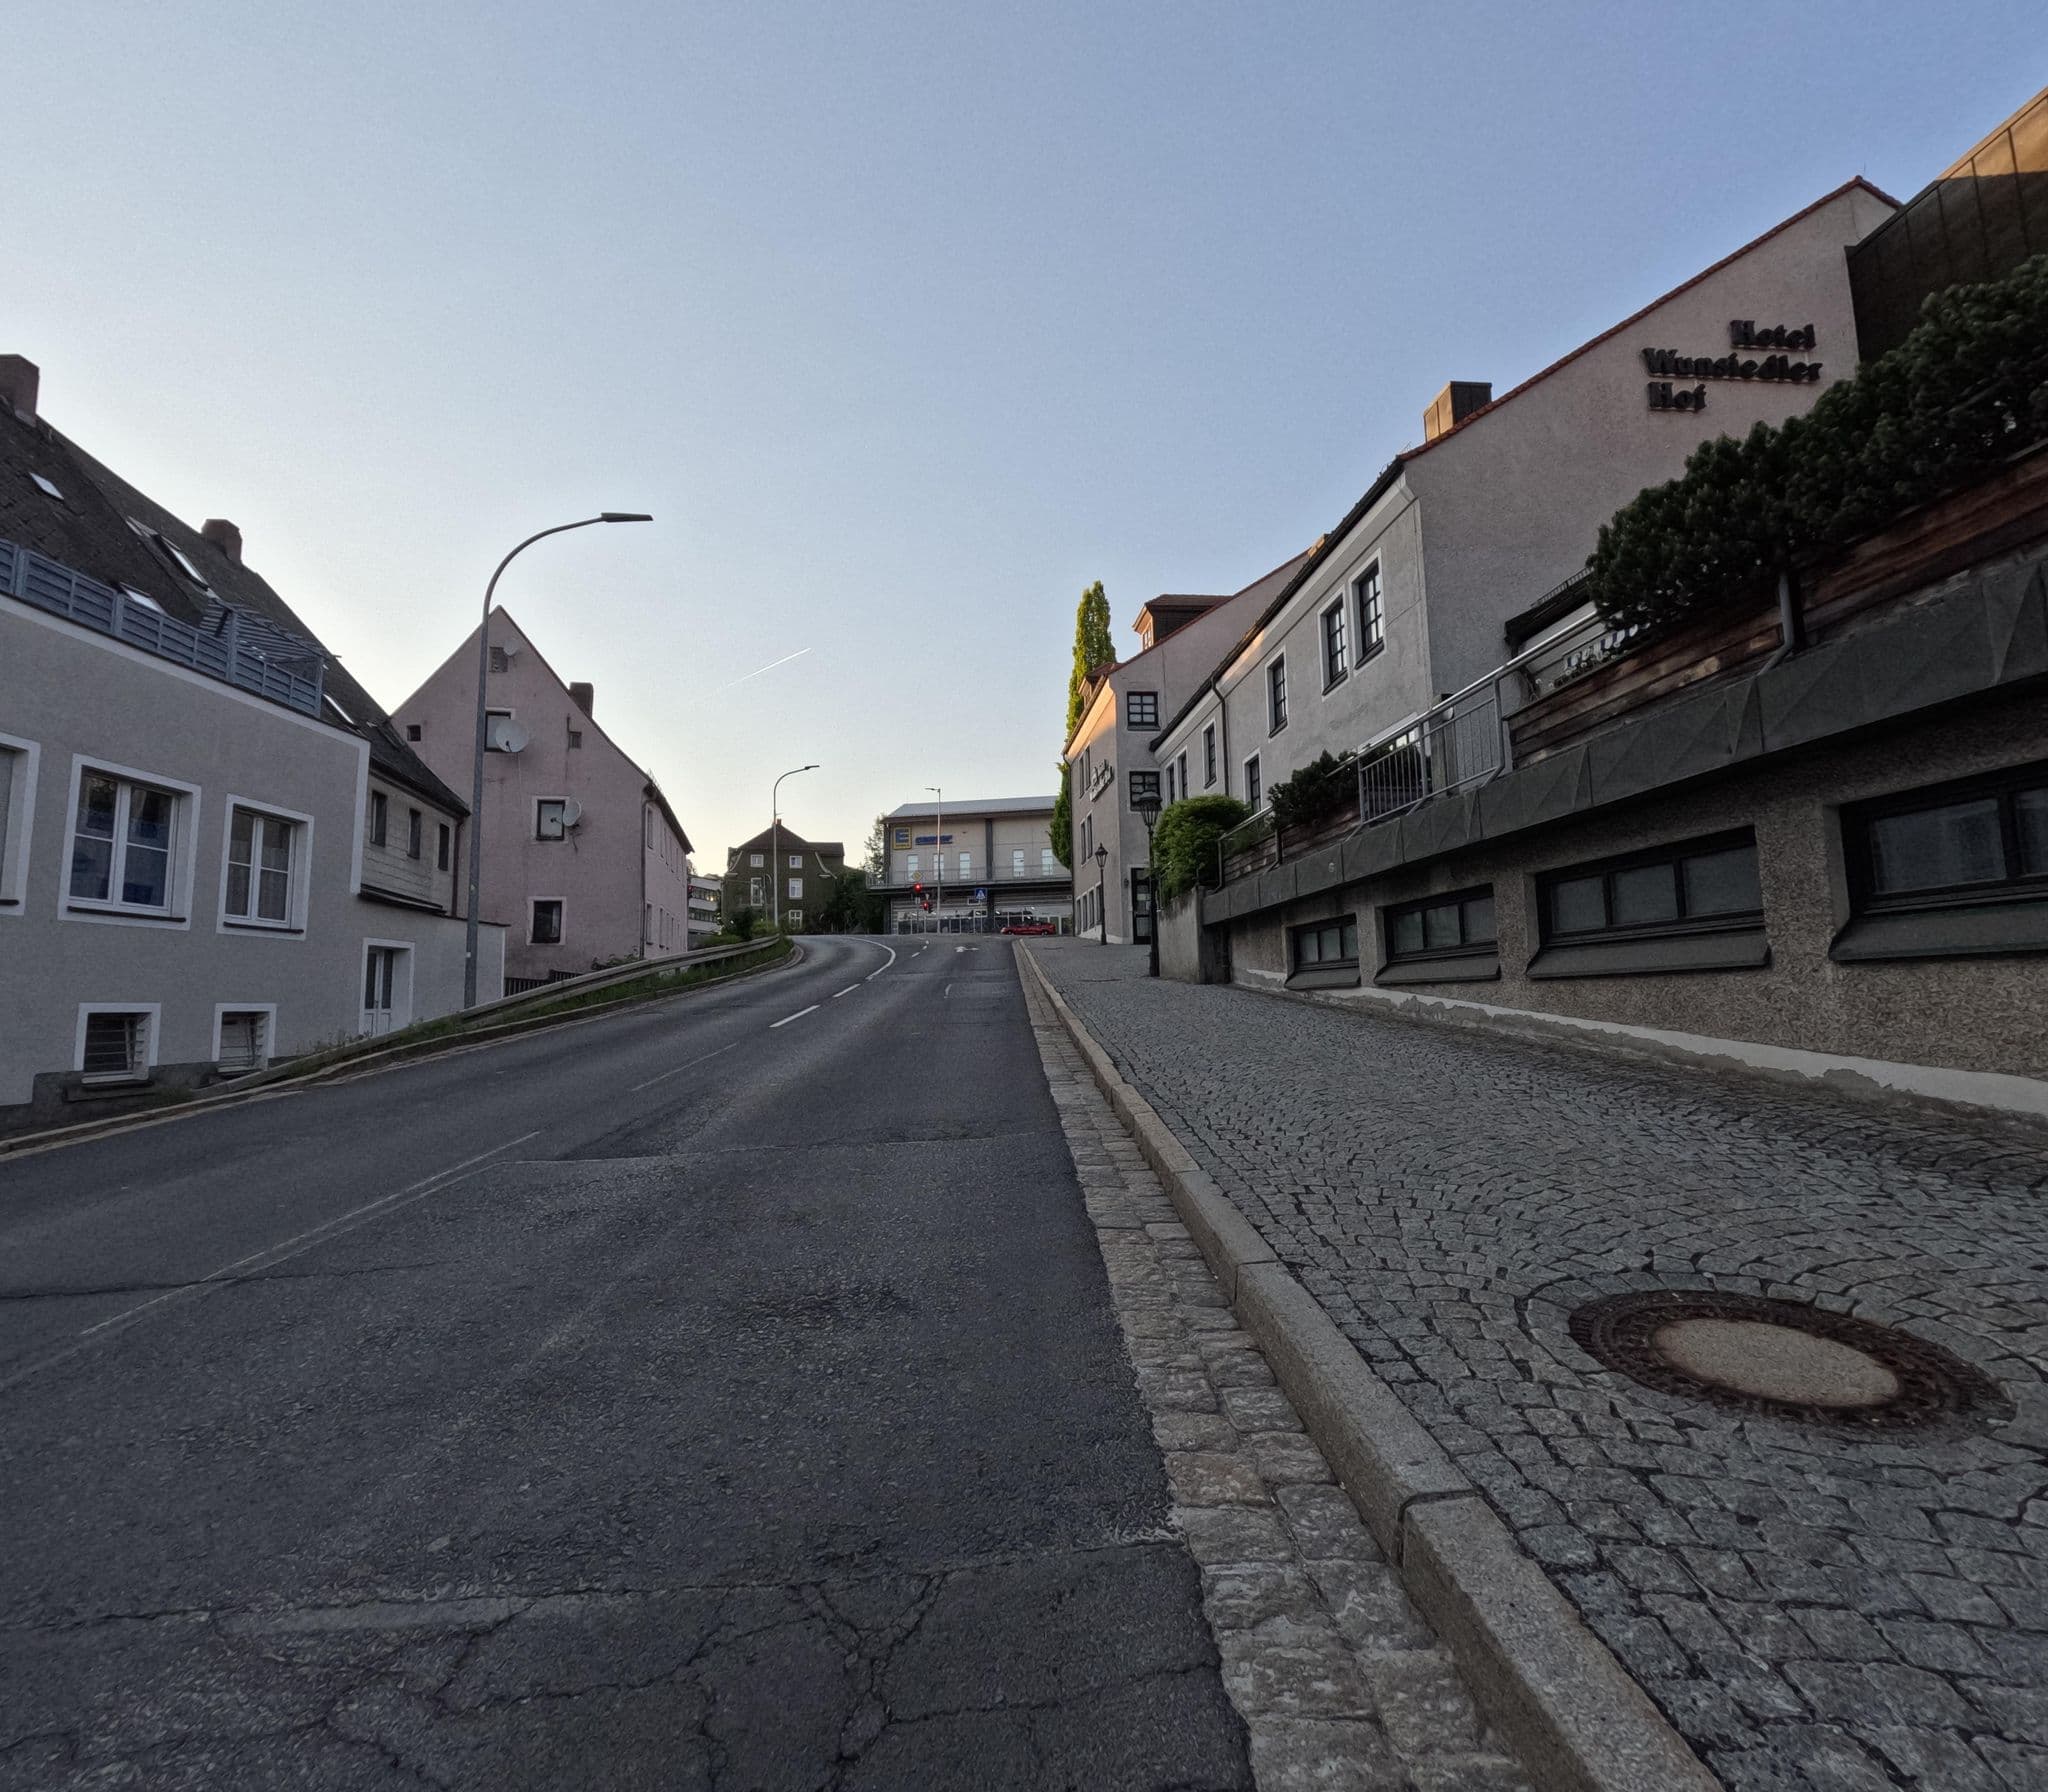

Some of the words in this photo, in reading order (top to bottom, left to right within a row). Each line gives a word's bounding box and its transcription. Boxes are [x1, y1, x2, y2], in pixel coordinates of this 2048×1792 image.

[1730, 320, 1816, 350] Hotel
[1642, 347, 1823, 382] Wunsiedler
[1647, 382, 1706, 411] Hof
